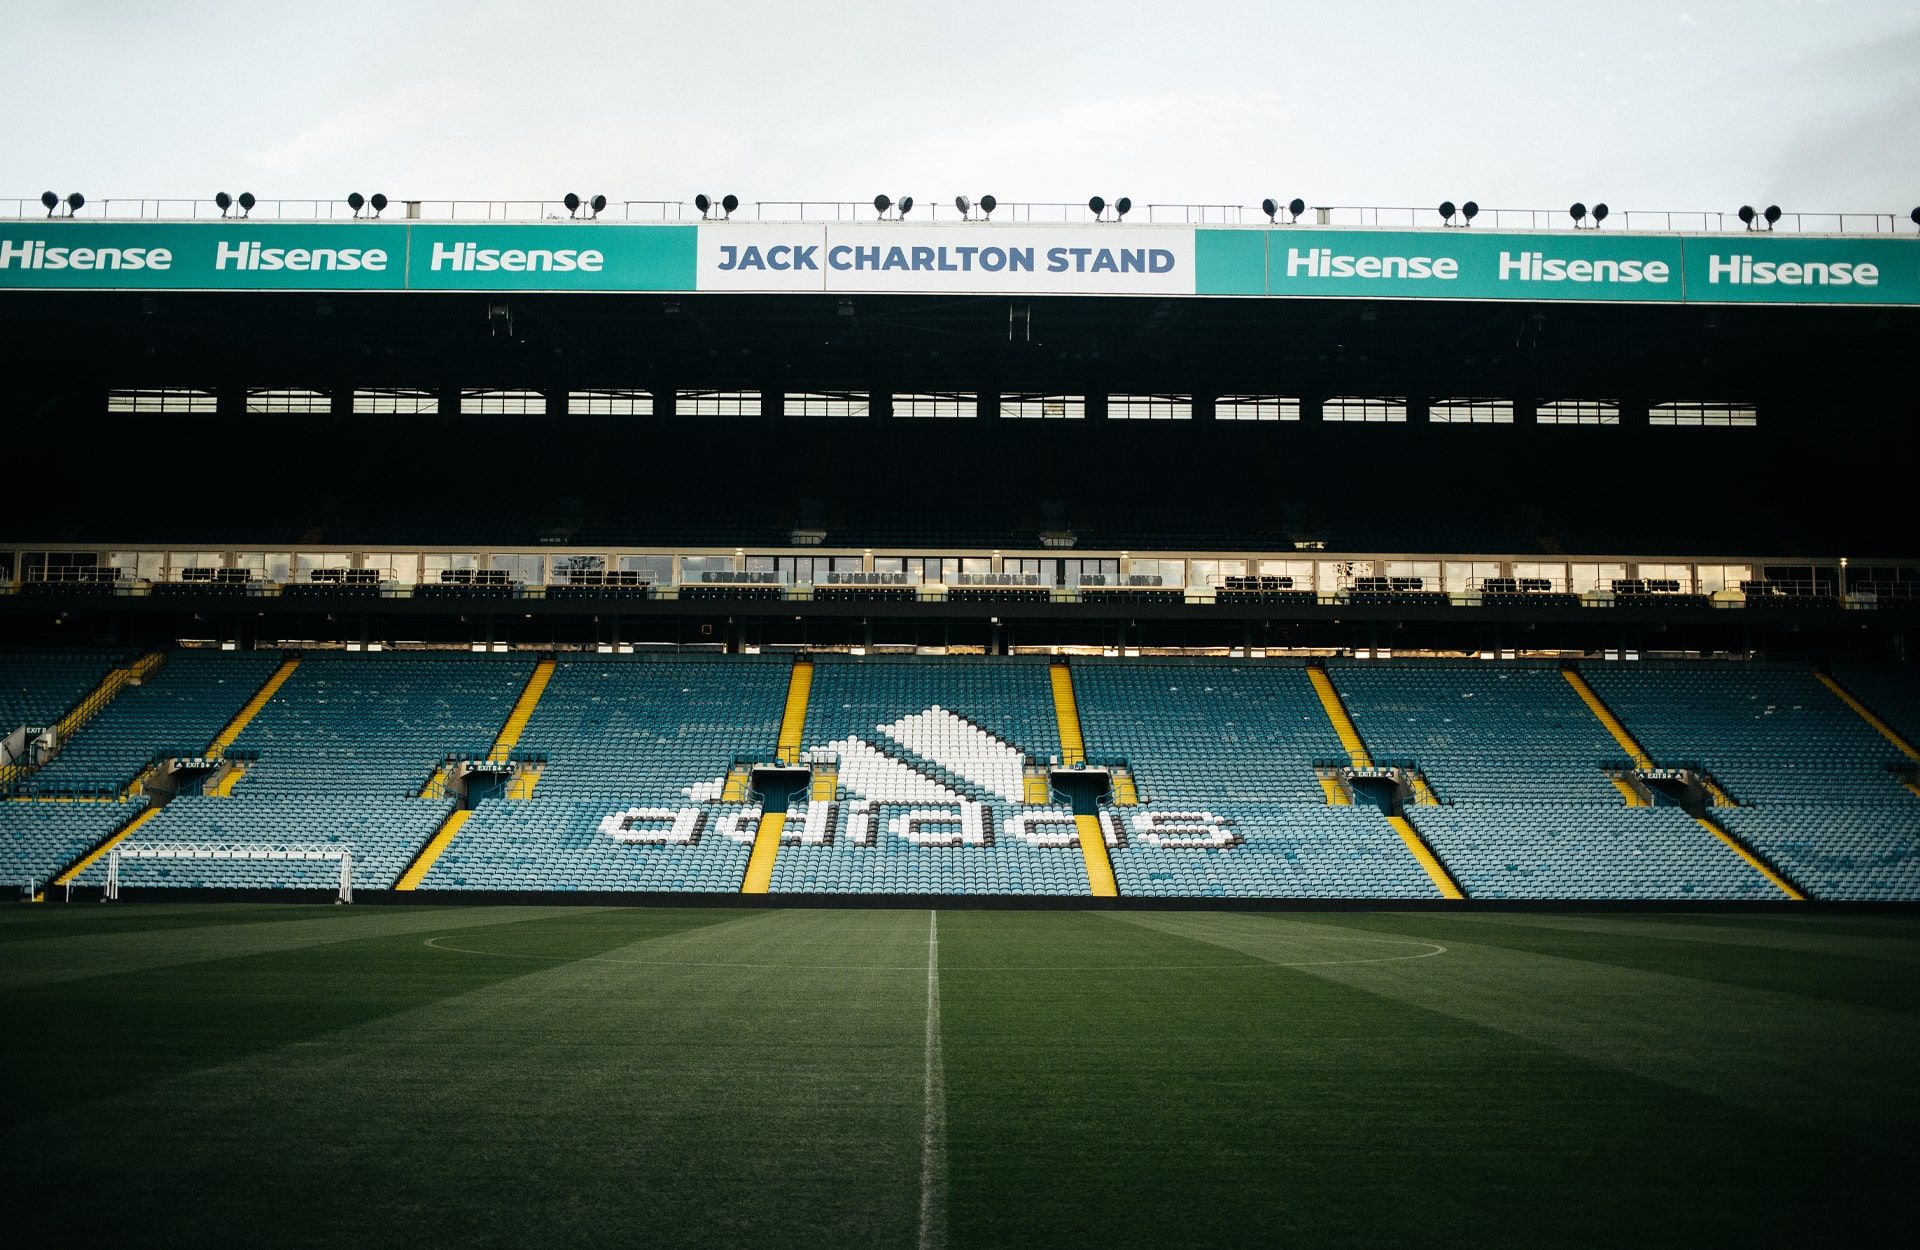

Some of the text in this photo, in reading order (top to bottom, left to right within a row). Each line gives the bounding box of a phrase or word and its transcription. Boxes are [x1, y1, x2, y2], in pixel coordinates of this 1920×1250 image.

[0, 241, 173, 270] Hisense
[216, 241, 388, 271] Hisense
[431, 243, 604, 272] Hisense
[718, 245, 1176, 273] JACK CHARLTON STAND
[1287, 248, 1459, 280] Hisense
[1499, 251, 1670, 283] Hisense
[1709, 254, 1879, 286] Hisense
[598, 797, 1247, 850] adidas
